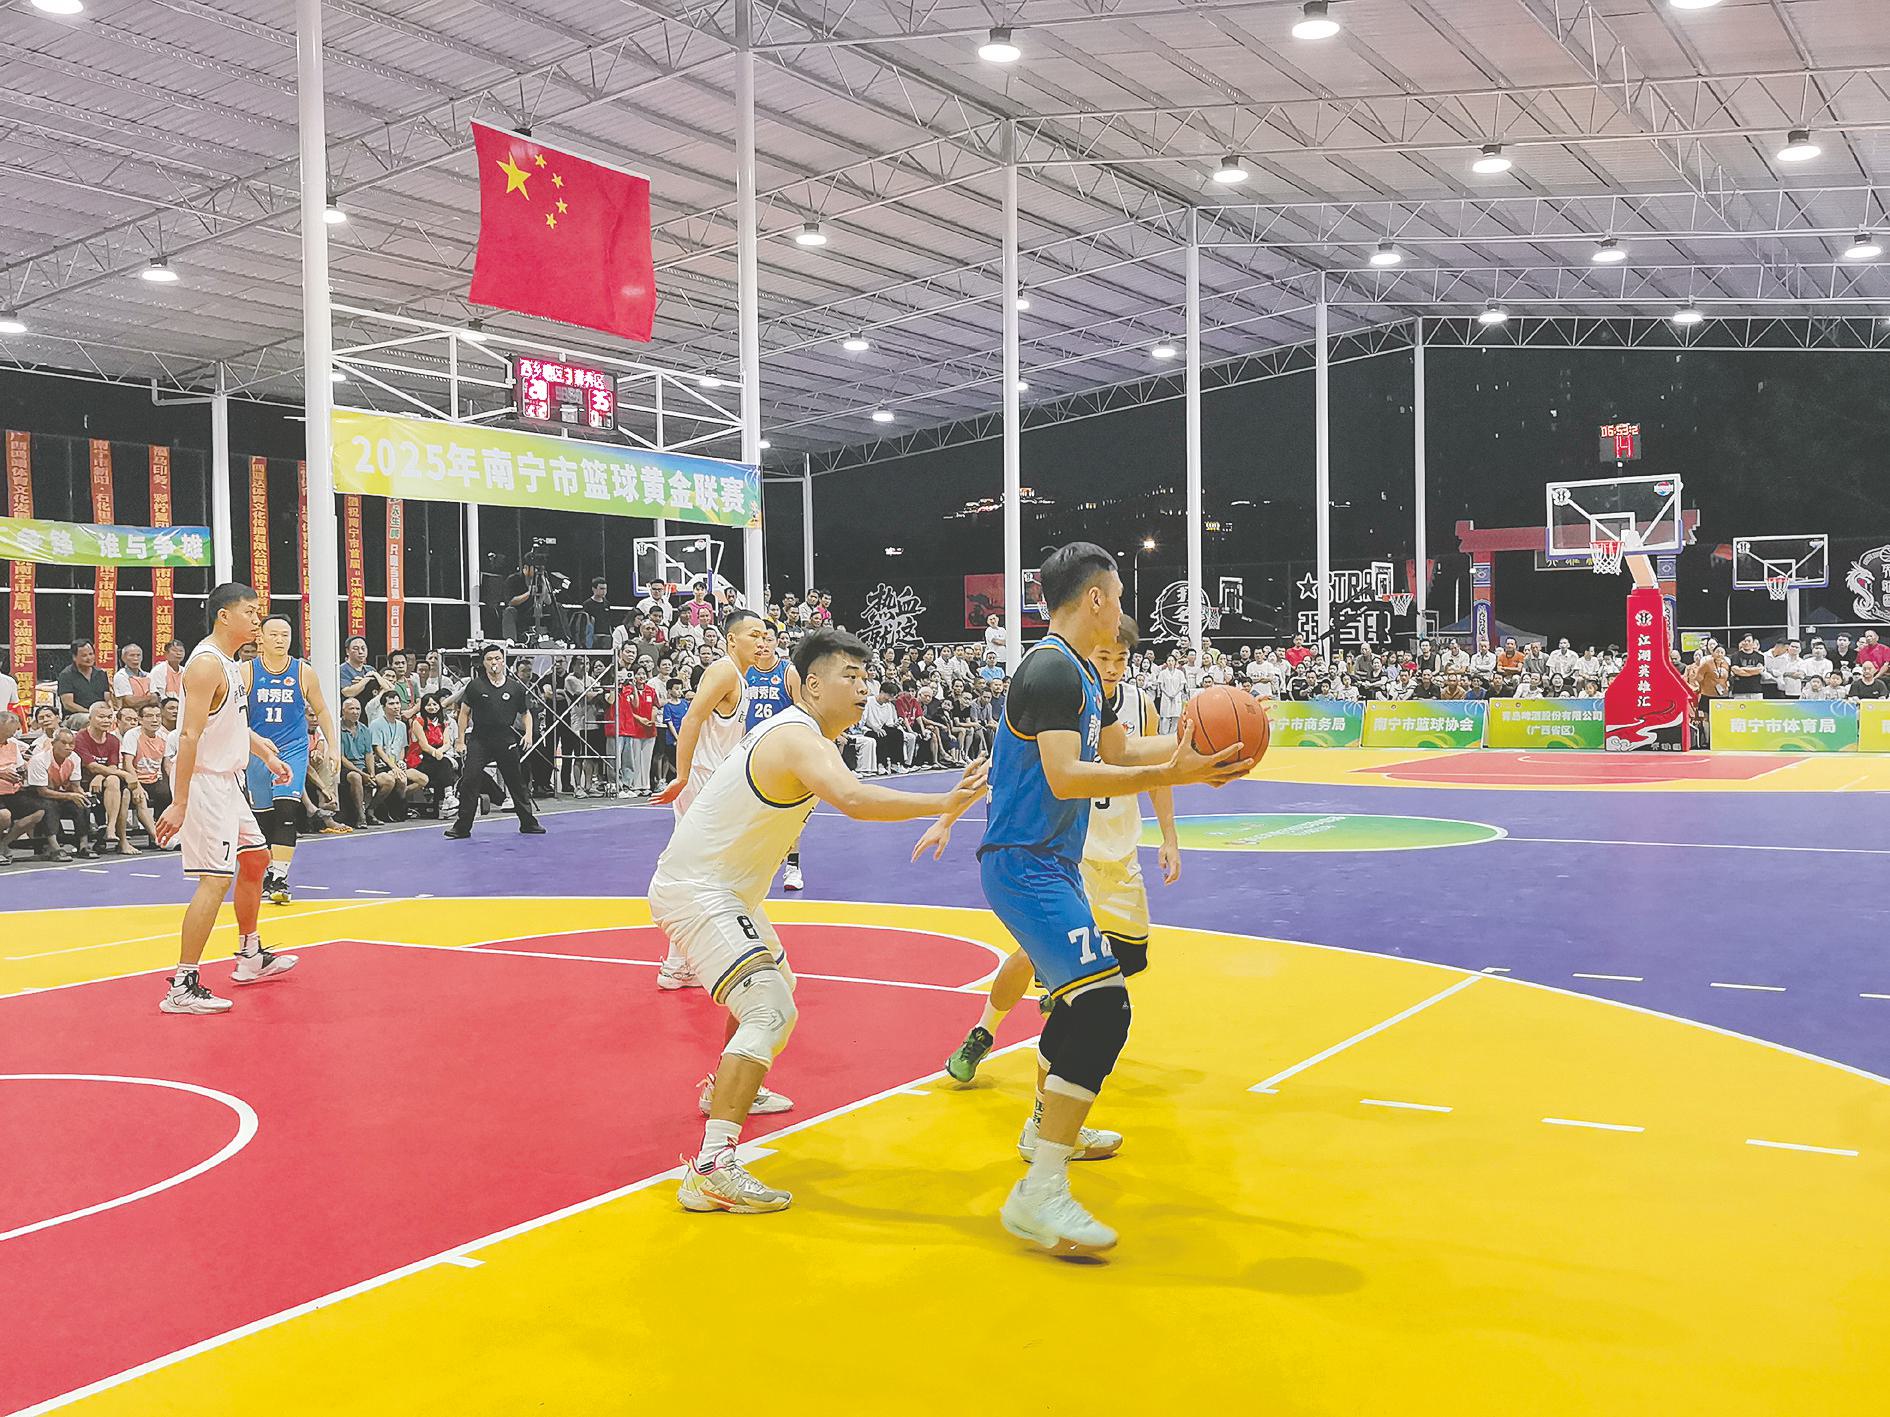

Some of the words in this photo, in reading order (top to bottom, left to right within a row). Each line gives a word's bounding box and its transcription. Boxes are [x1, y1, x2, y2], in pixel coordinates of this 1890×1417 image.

[351, 434, 746, 515] 2025年南宁市篮球黄金联赛
[98, 532, 205, 561] 谁与争雄
[1637, 633, 1652, 708] 江湖英雄汇
[256, 688, 295, 703] 青秀区
[748, 685, 780, 700] 青秀区
[264, 707, 283, 723] 11
[754, 703, 773, 719] 26
[1502, 710, 1603, 721] 青岛啤酒股份有限公司
[1373, 717, 1475, 732] 南宁市篮球协会
[1729, 718, 1837, 734] 南宁市体育局
[222, 840, 231, 862] 7
[736, 915, 760, 940] 8
